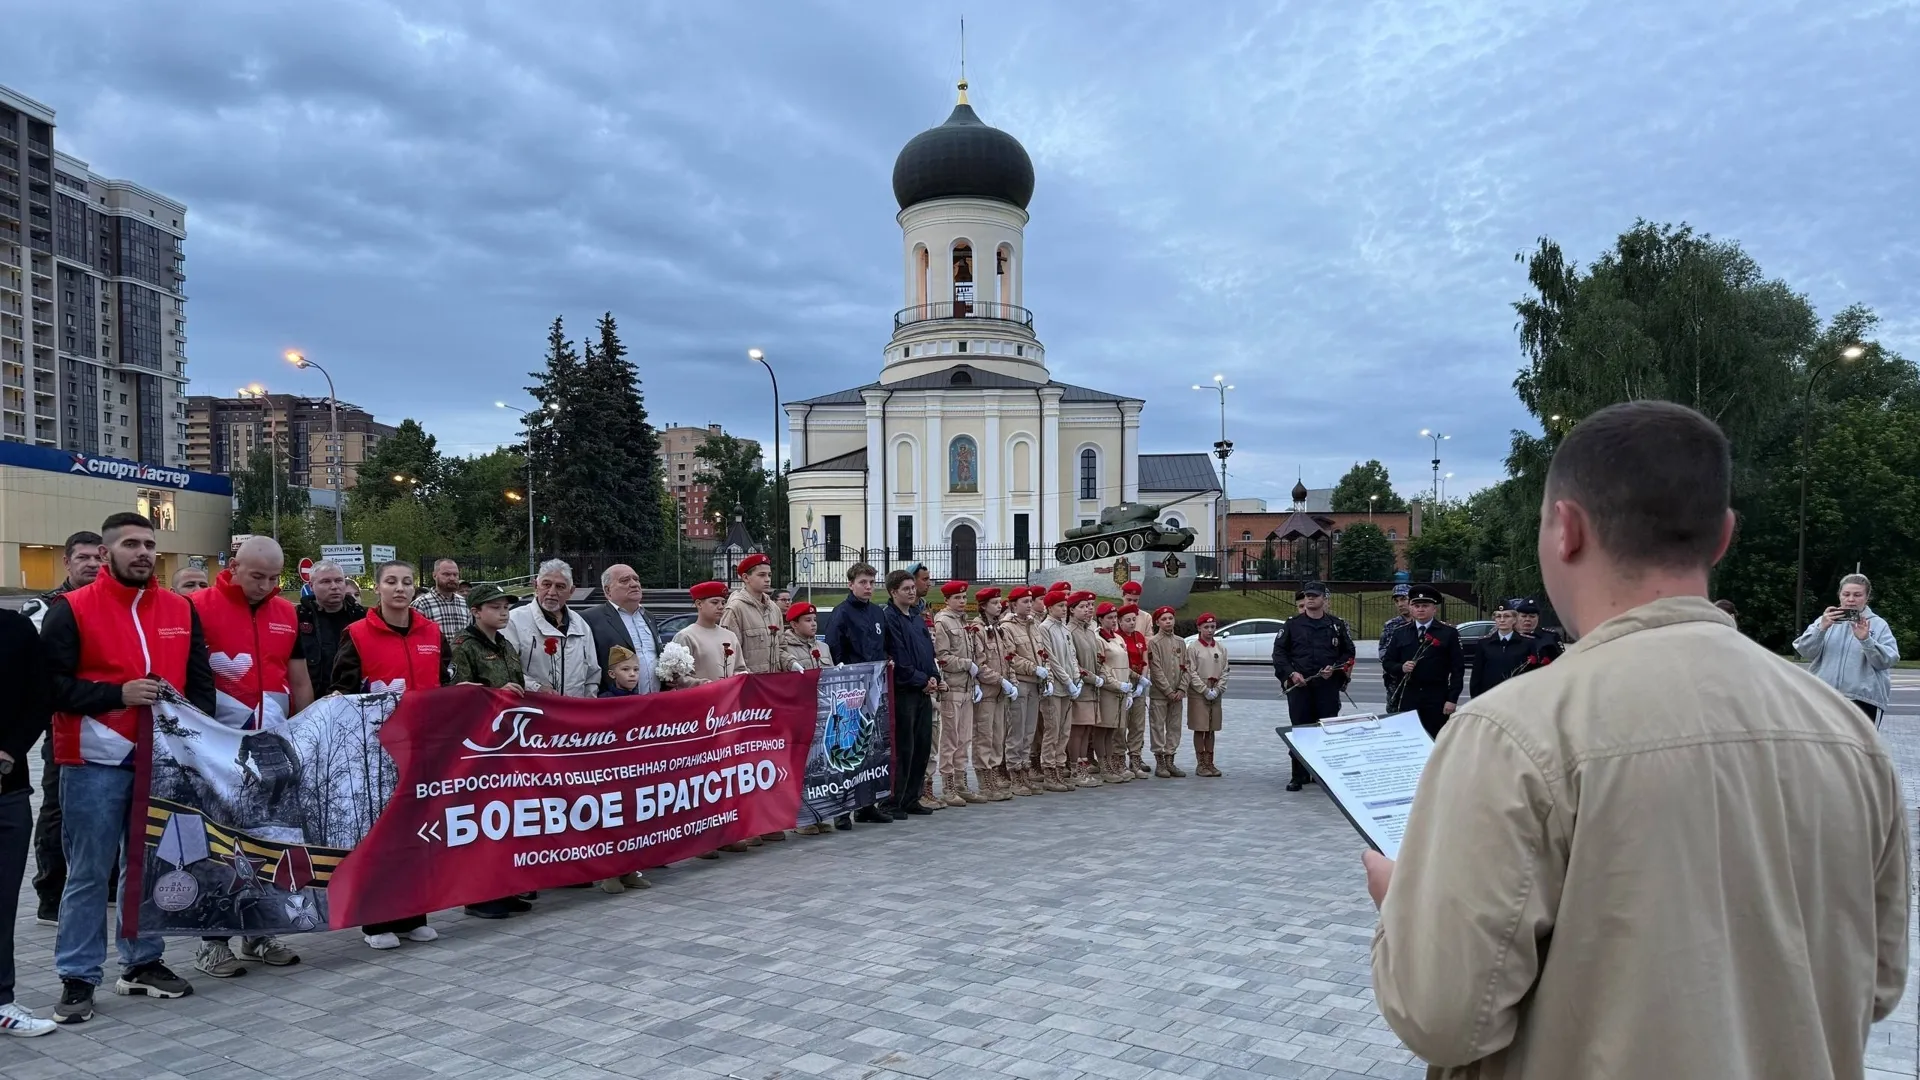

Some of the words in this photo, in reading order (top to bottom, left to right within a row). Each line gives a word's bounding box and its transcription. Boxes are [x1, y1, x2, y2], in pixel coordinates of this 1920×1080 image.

[874, 622, 882, 635] 8
[836, 689, 866, 700] Боевое
[462, 706, 618, 752] Память
[626, 719, 699, 742] сильнее
[705, 705, 773, 737] времени
[416, 770, 563, 799] ВСЕРОССИЙСКАЯ
[564, 759, 668, 787] ОБЩЕСТВЕННАЯ
[669, 745, 732, 772] ОРГАНИЗАЦИЯ
[734, 738, 785, 756] ВЕТЕРАНОВ
[807, 764, 889, 800] НАРО-ФОМИНСК
[416, 790, 624, 848] «БОЕВОЕ
[635, 759, 789, 823] БРАТСТВО»
[513, 841, 614, 868] МОСКОВСКОЕ
[617, 825, 683, 854] ОБЛАСТНОЕ
[683, 808, 739, 836] ОТДЕЛЕНИЕ
